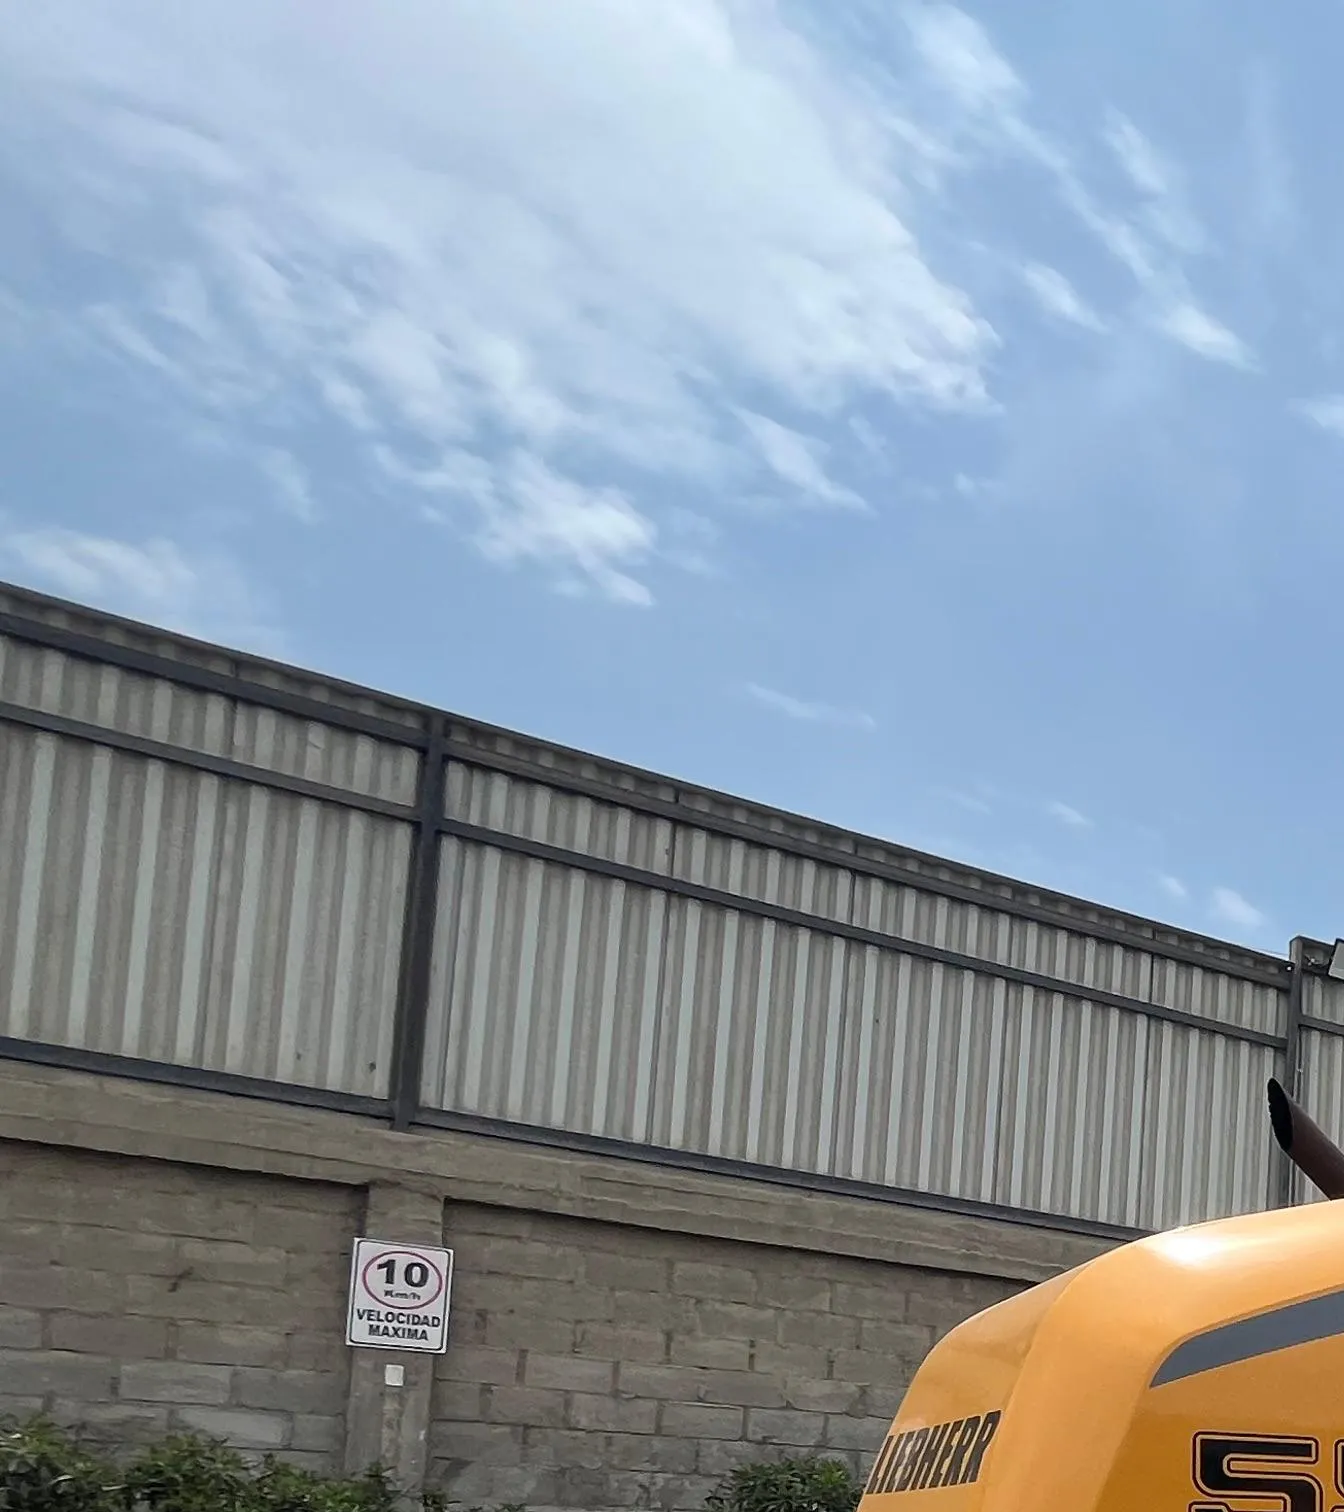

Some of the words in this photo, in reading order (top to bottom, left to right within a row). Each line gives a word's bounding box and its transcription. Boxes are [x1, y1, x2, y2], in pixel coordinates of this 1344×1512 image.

[377, 1259, 429, 1288] 10
[356, 1308, 441, 1328] VELOCIDAD
[368, 1324, 428, 1341] MAXIMA
[865, 1409, 1001, 1494] LIEBHERR
